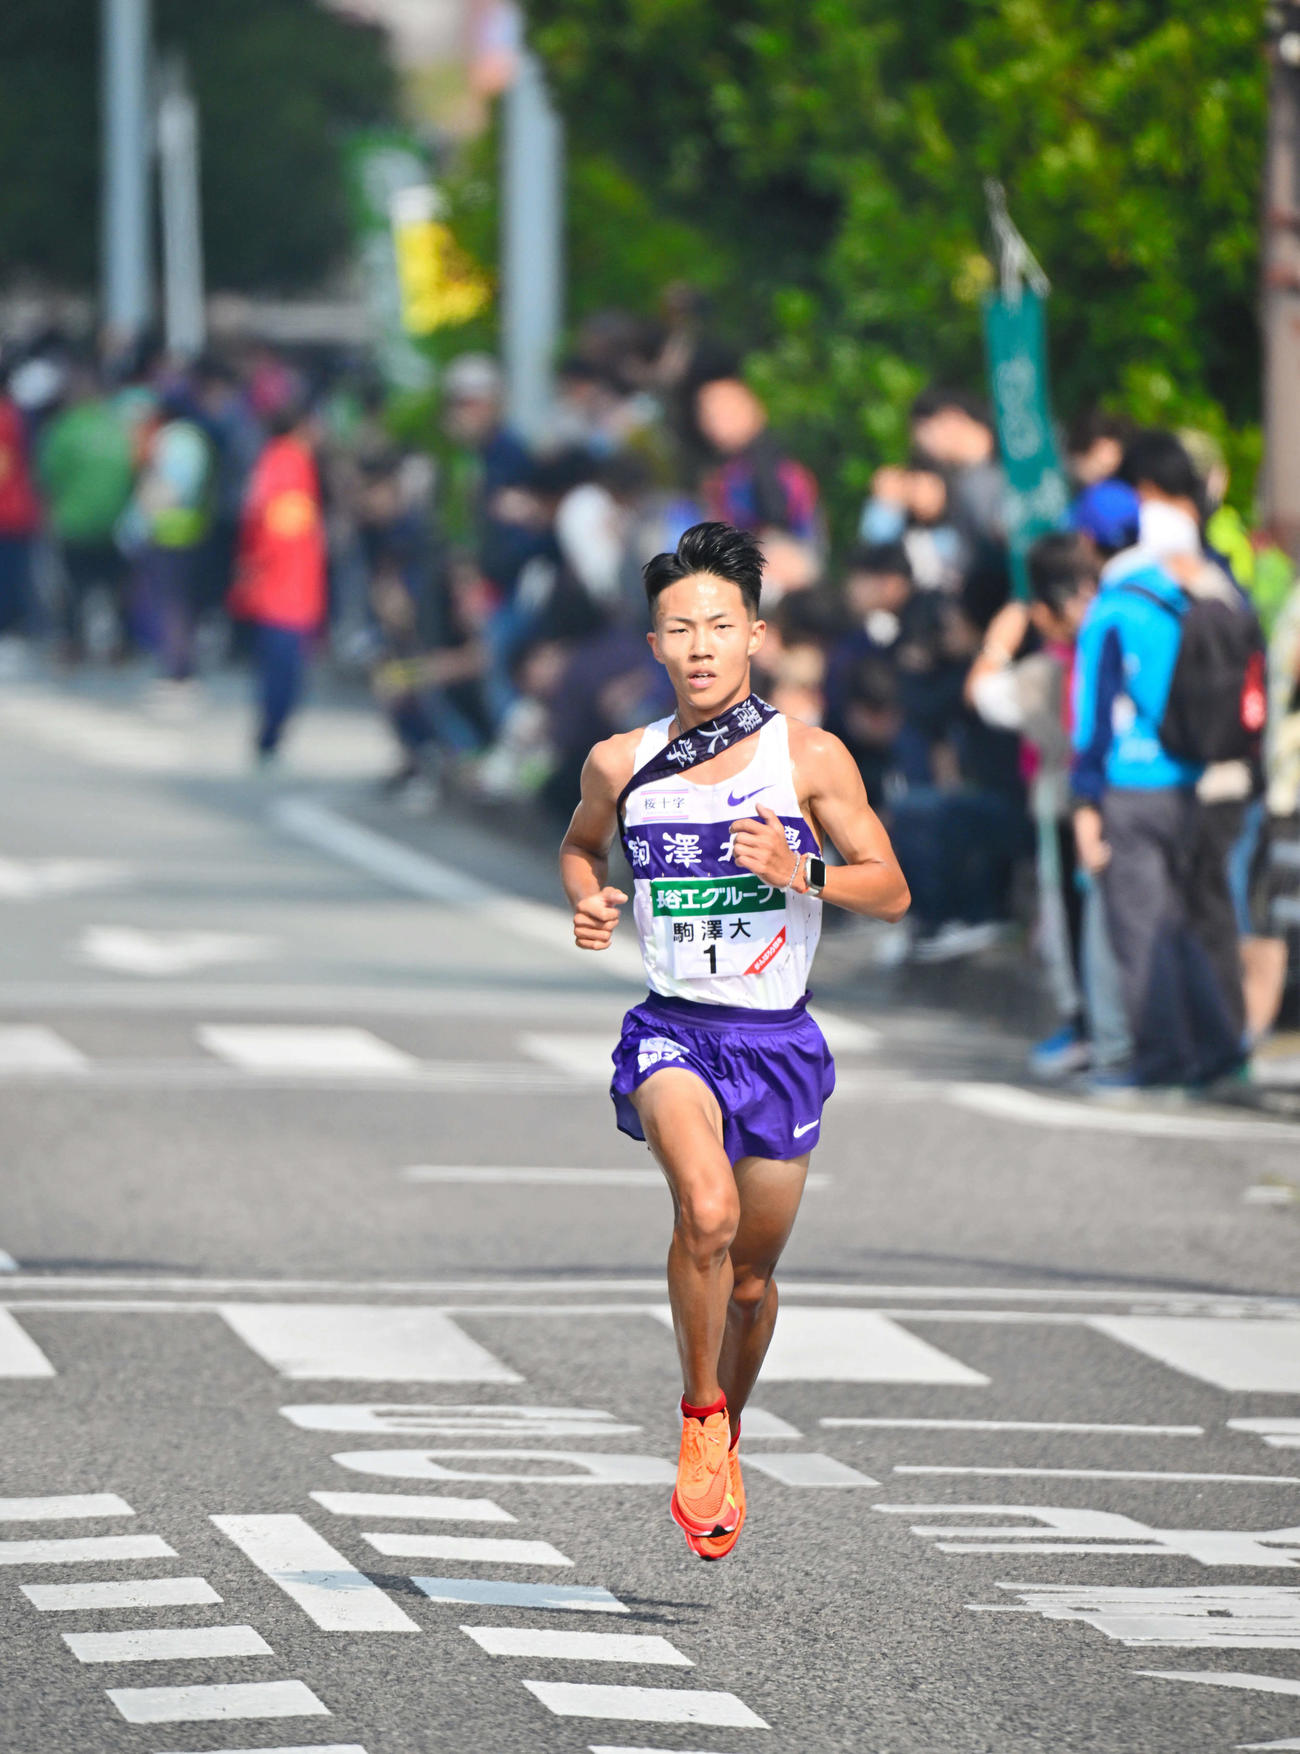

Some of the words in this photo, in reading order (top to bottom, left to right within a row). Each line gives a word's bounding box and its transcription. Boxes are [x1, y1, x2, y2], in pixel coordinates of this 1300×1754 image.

[666, 693, 776, 767] 澤大学
[644, 796, 686, 810] 桜十字
[673, 917, 751, 943] 駒澤大
[703, 944, 718, 974] 1
